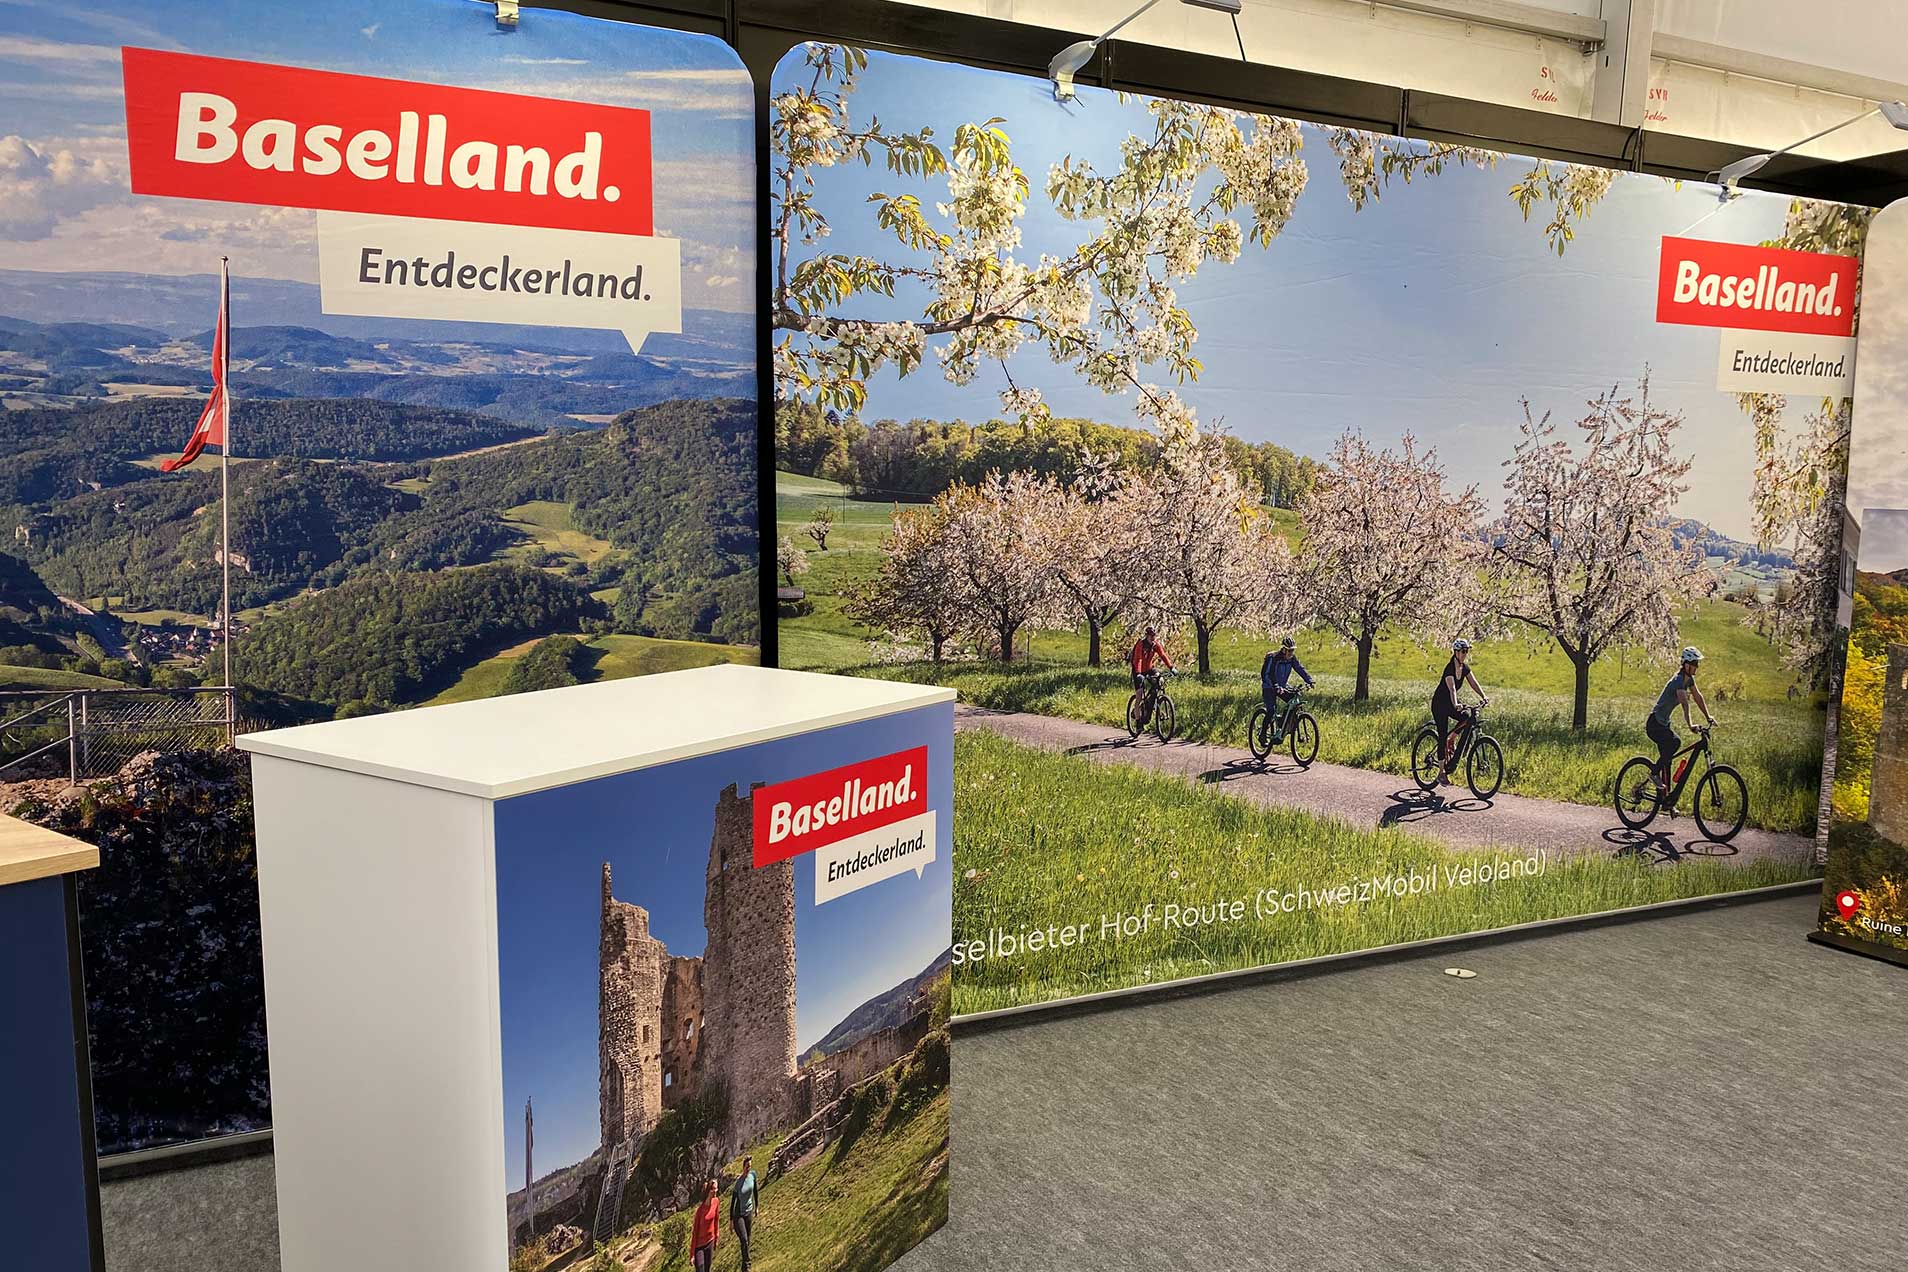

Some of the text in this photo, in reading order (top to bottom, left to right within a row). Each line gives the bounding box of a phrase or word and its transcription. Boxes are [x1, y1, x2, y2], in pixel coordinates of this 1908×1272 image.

[174, 91, 621, 202] Baselland.
[358, 246, 652, 302] Entdeckerland.
[1673, 260, 1842, 317] Baselland.
[1732, 349, 1846, 378] Entdeckerland.
[768, 764, 917, 844] Baselland.
[828, 829, 926, 883] Entdeckerland.
[1100, 899, 1245, 940] Hof-Route
[1255, 864, 1437, 920] (SchweizMobil
[1444, 849, 1546, 888] Veloland)
[1862, 916, 1902, 935] Ruine
